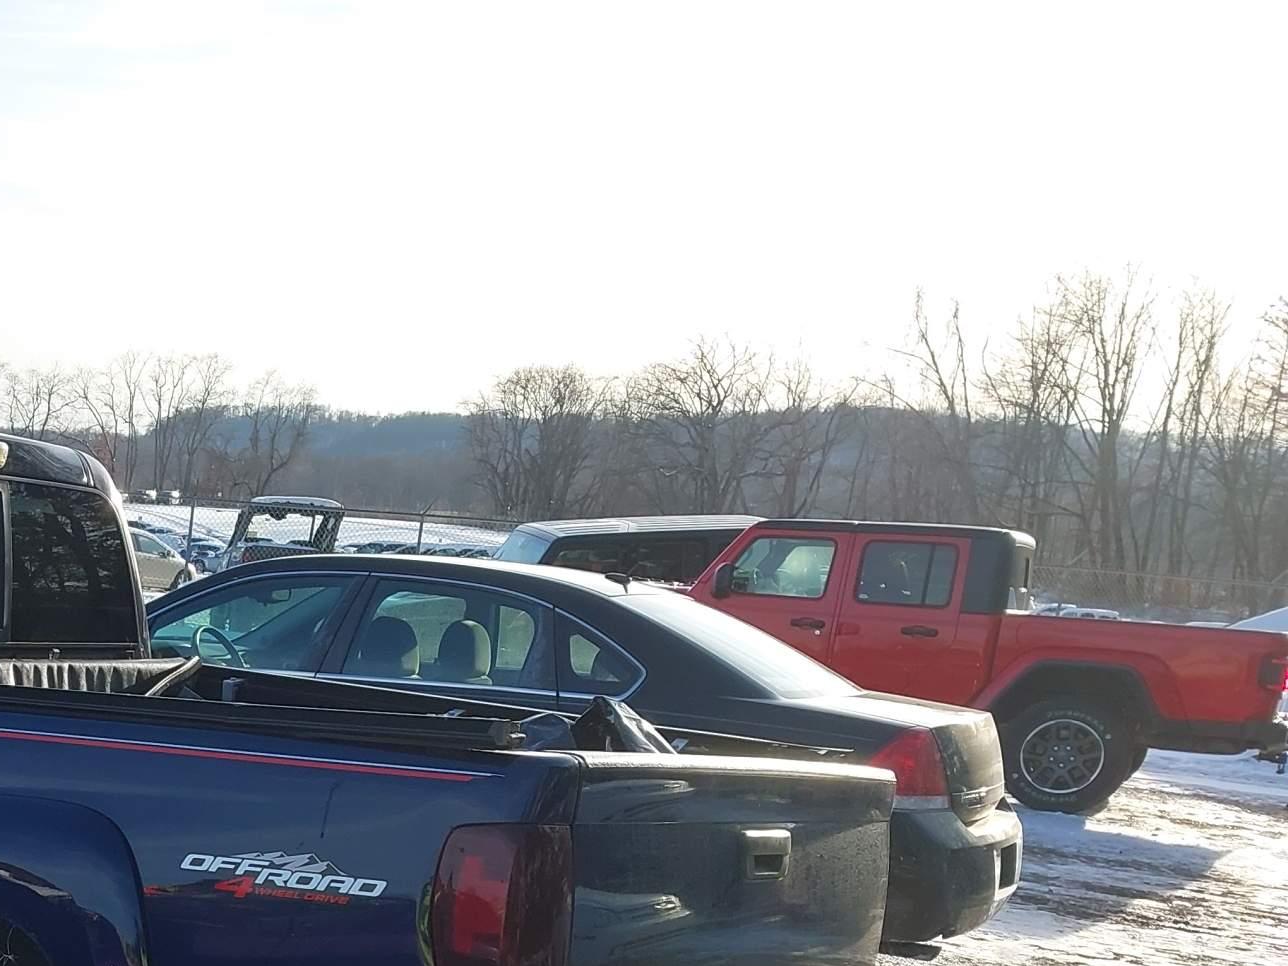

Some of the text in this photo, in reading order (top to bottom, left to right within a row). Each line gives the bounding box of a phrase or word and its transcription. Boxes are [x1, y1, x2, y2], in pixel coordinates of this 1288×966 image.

[214, 876, 350, 905] 4 WHEEL DRIVE
